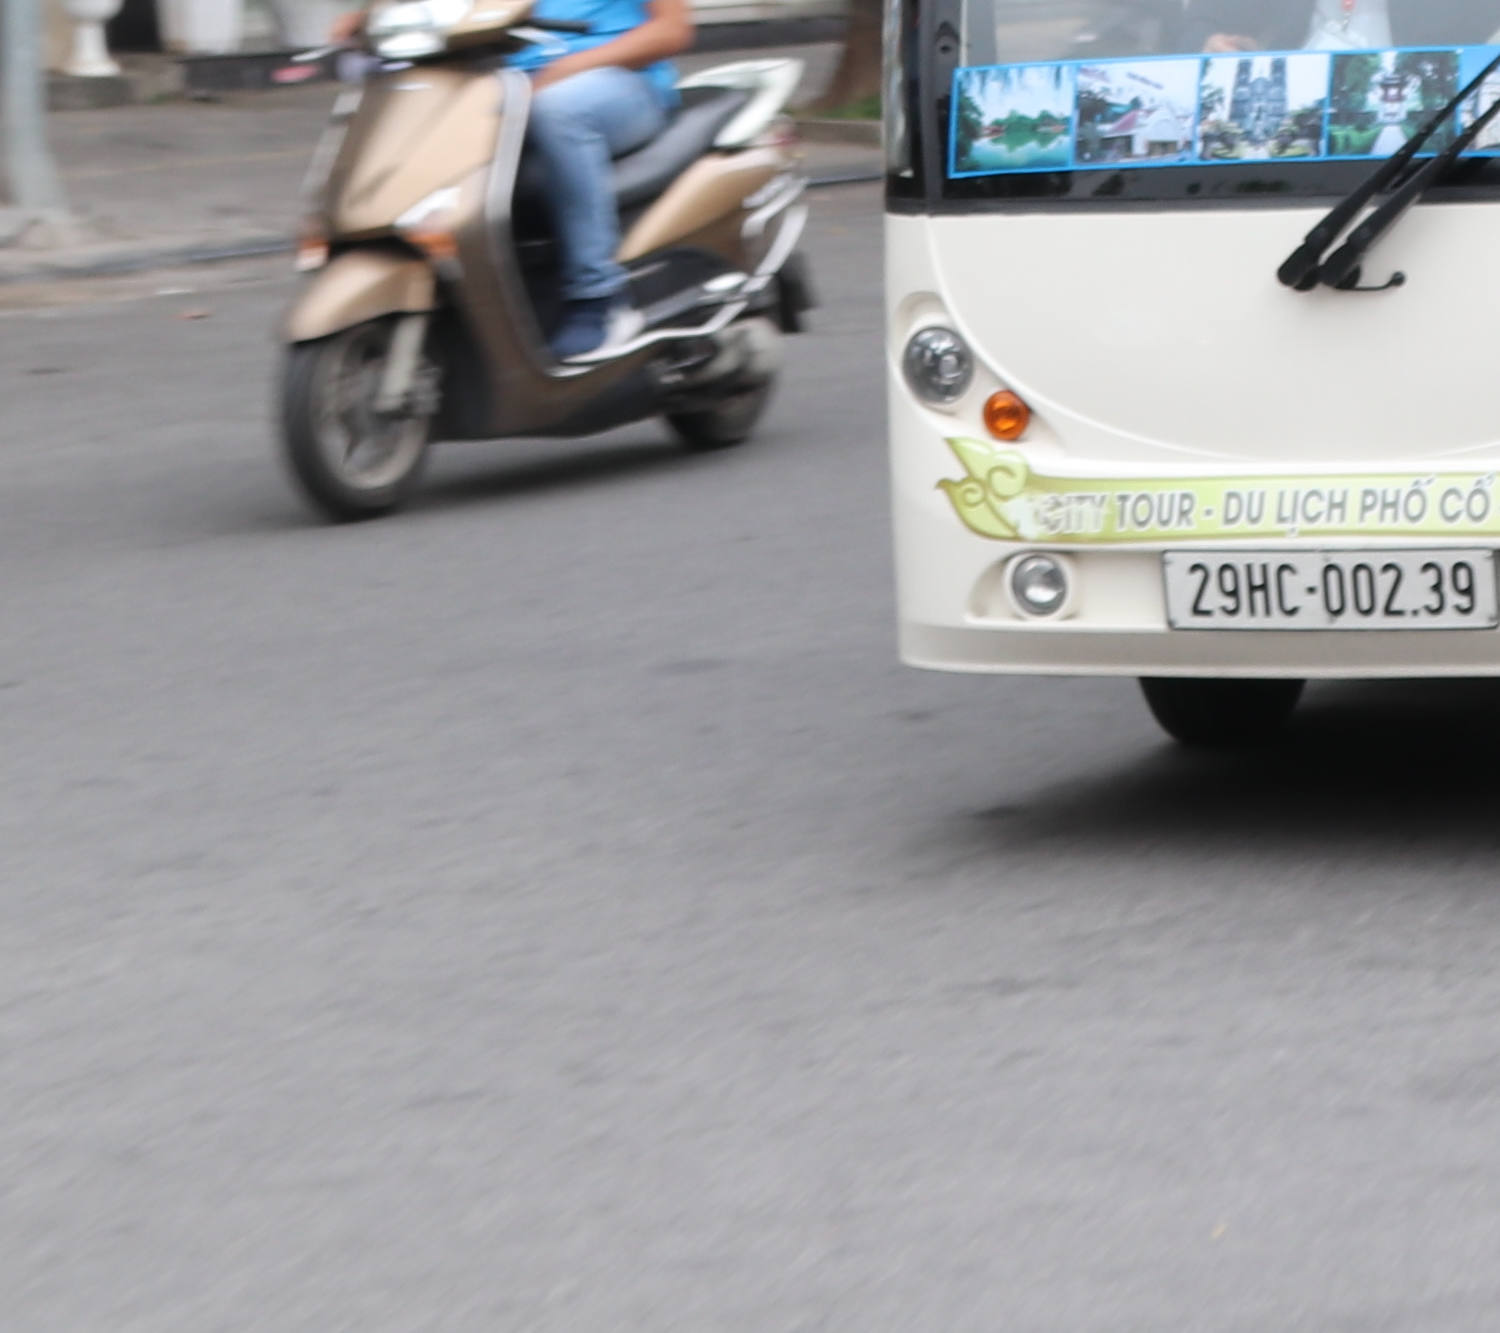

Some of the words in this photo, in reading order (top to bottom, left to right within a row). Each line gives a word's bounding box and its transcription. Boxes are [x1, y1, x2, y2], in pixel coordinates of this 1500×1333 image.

[1115, 489, 1197, 530] TOUR
[1223, 489, 1266, 526] DU
[1275, 486, 1349, 537] LỊCH
[1358, 474, 1437, 524] PHỐ
[1438, 473, 1496, 524] CỔ
[1188, 561, 1476, 618] 29HC-002.39
